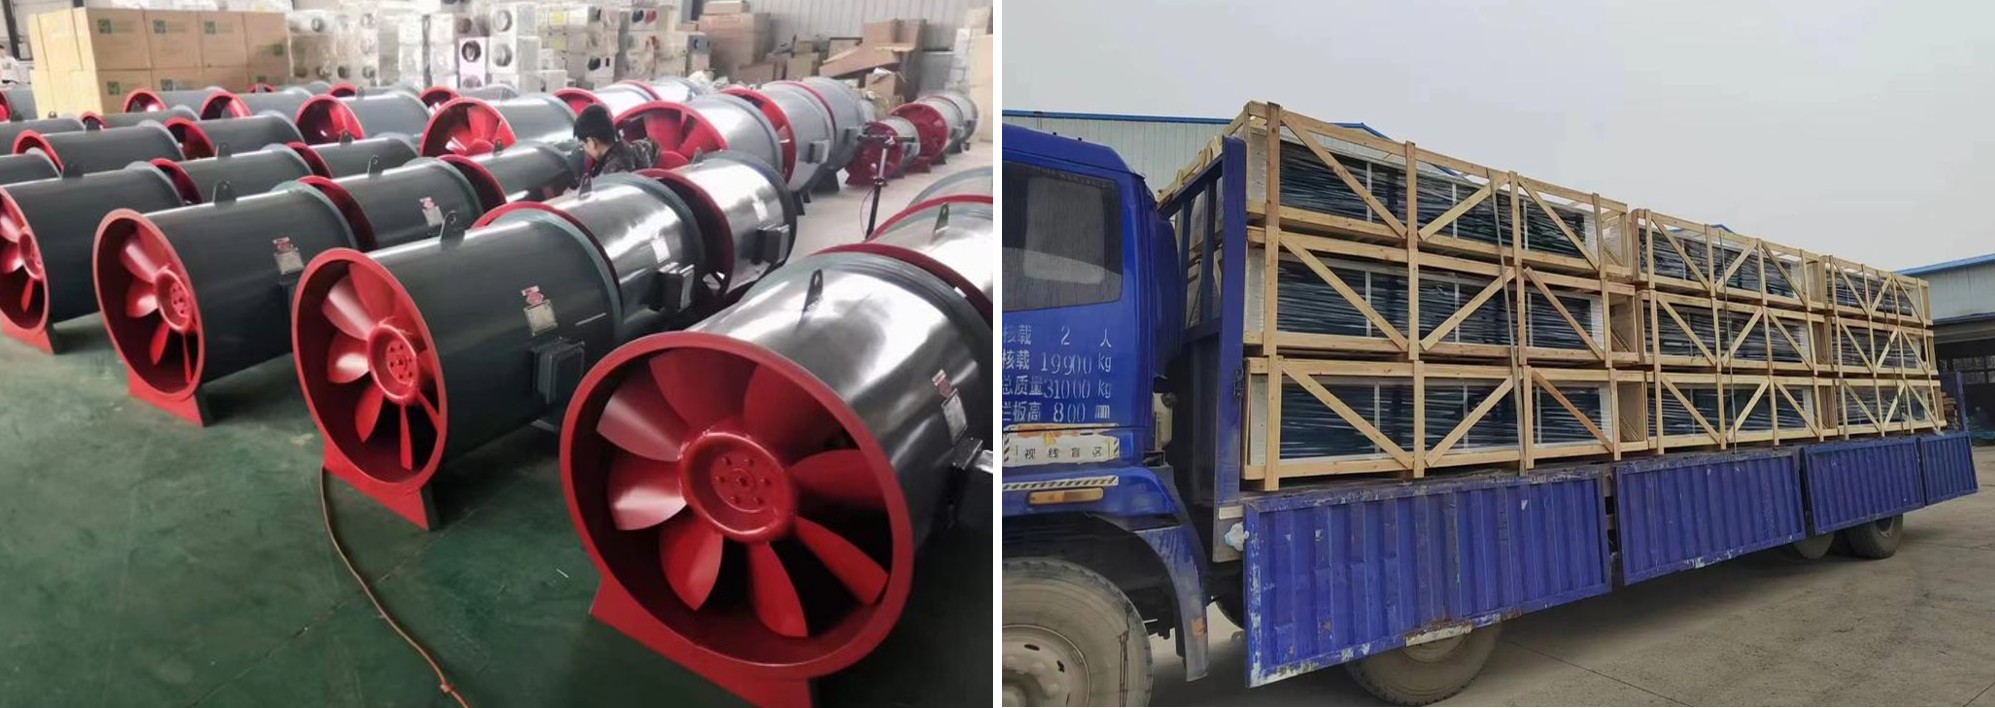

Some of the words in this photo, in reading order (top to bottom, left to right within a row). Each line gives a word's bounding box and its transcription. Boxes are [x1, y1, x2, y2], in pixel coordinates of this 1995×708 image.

[1060, 326, 1070, 346] 2
[1100, 328, 1111, 348] 人
[1041, 353, 1092, 375] 19900
[1098, 353, 1111, 373] kg
[1002, 375, 1043, 396] 总质量
[1043, 379, 1091, 399] 31000
[1098, 380, 1111, 399] kg
[1053, 403, 1085, 423] 800
